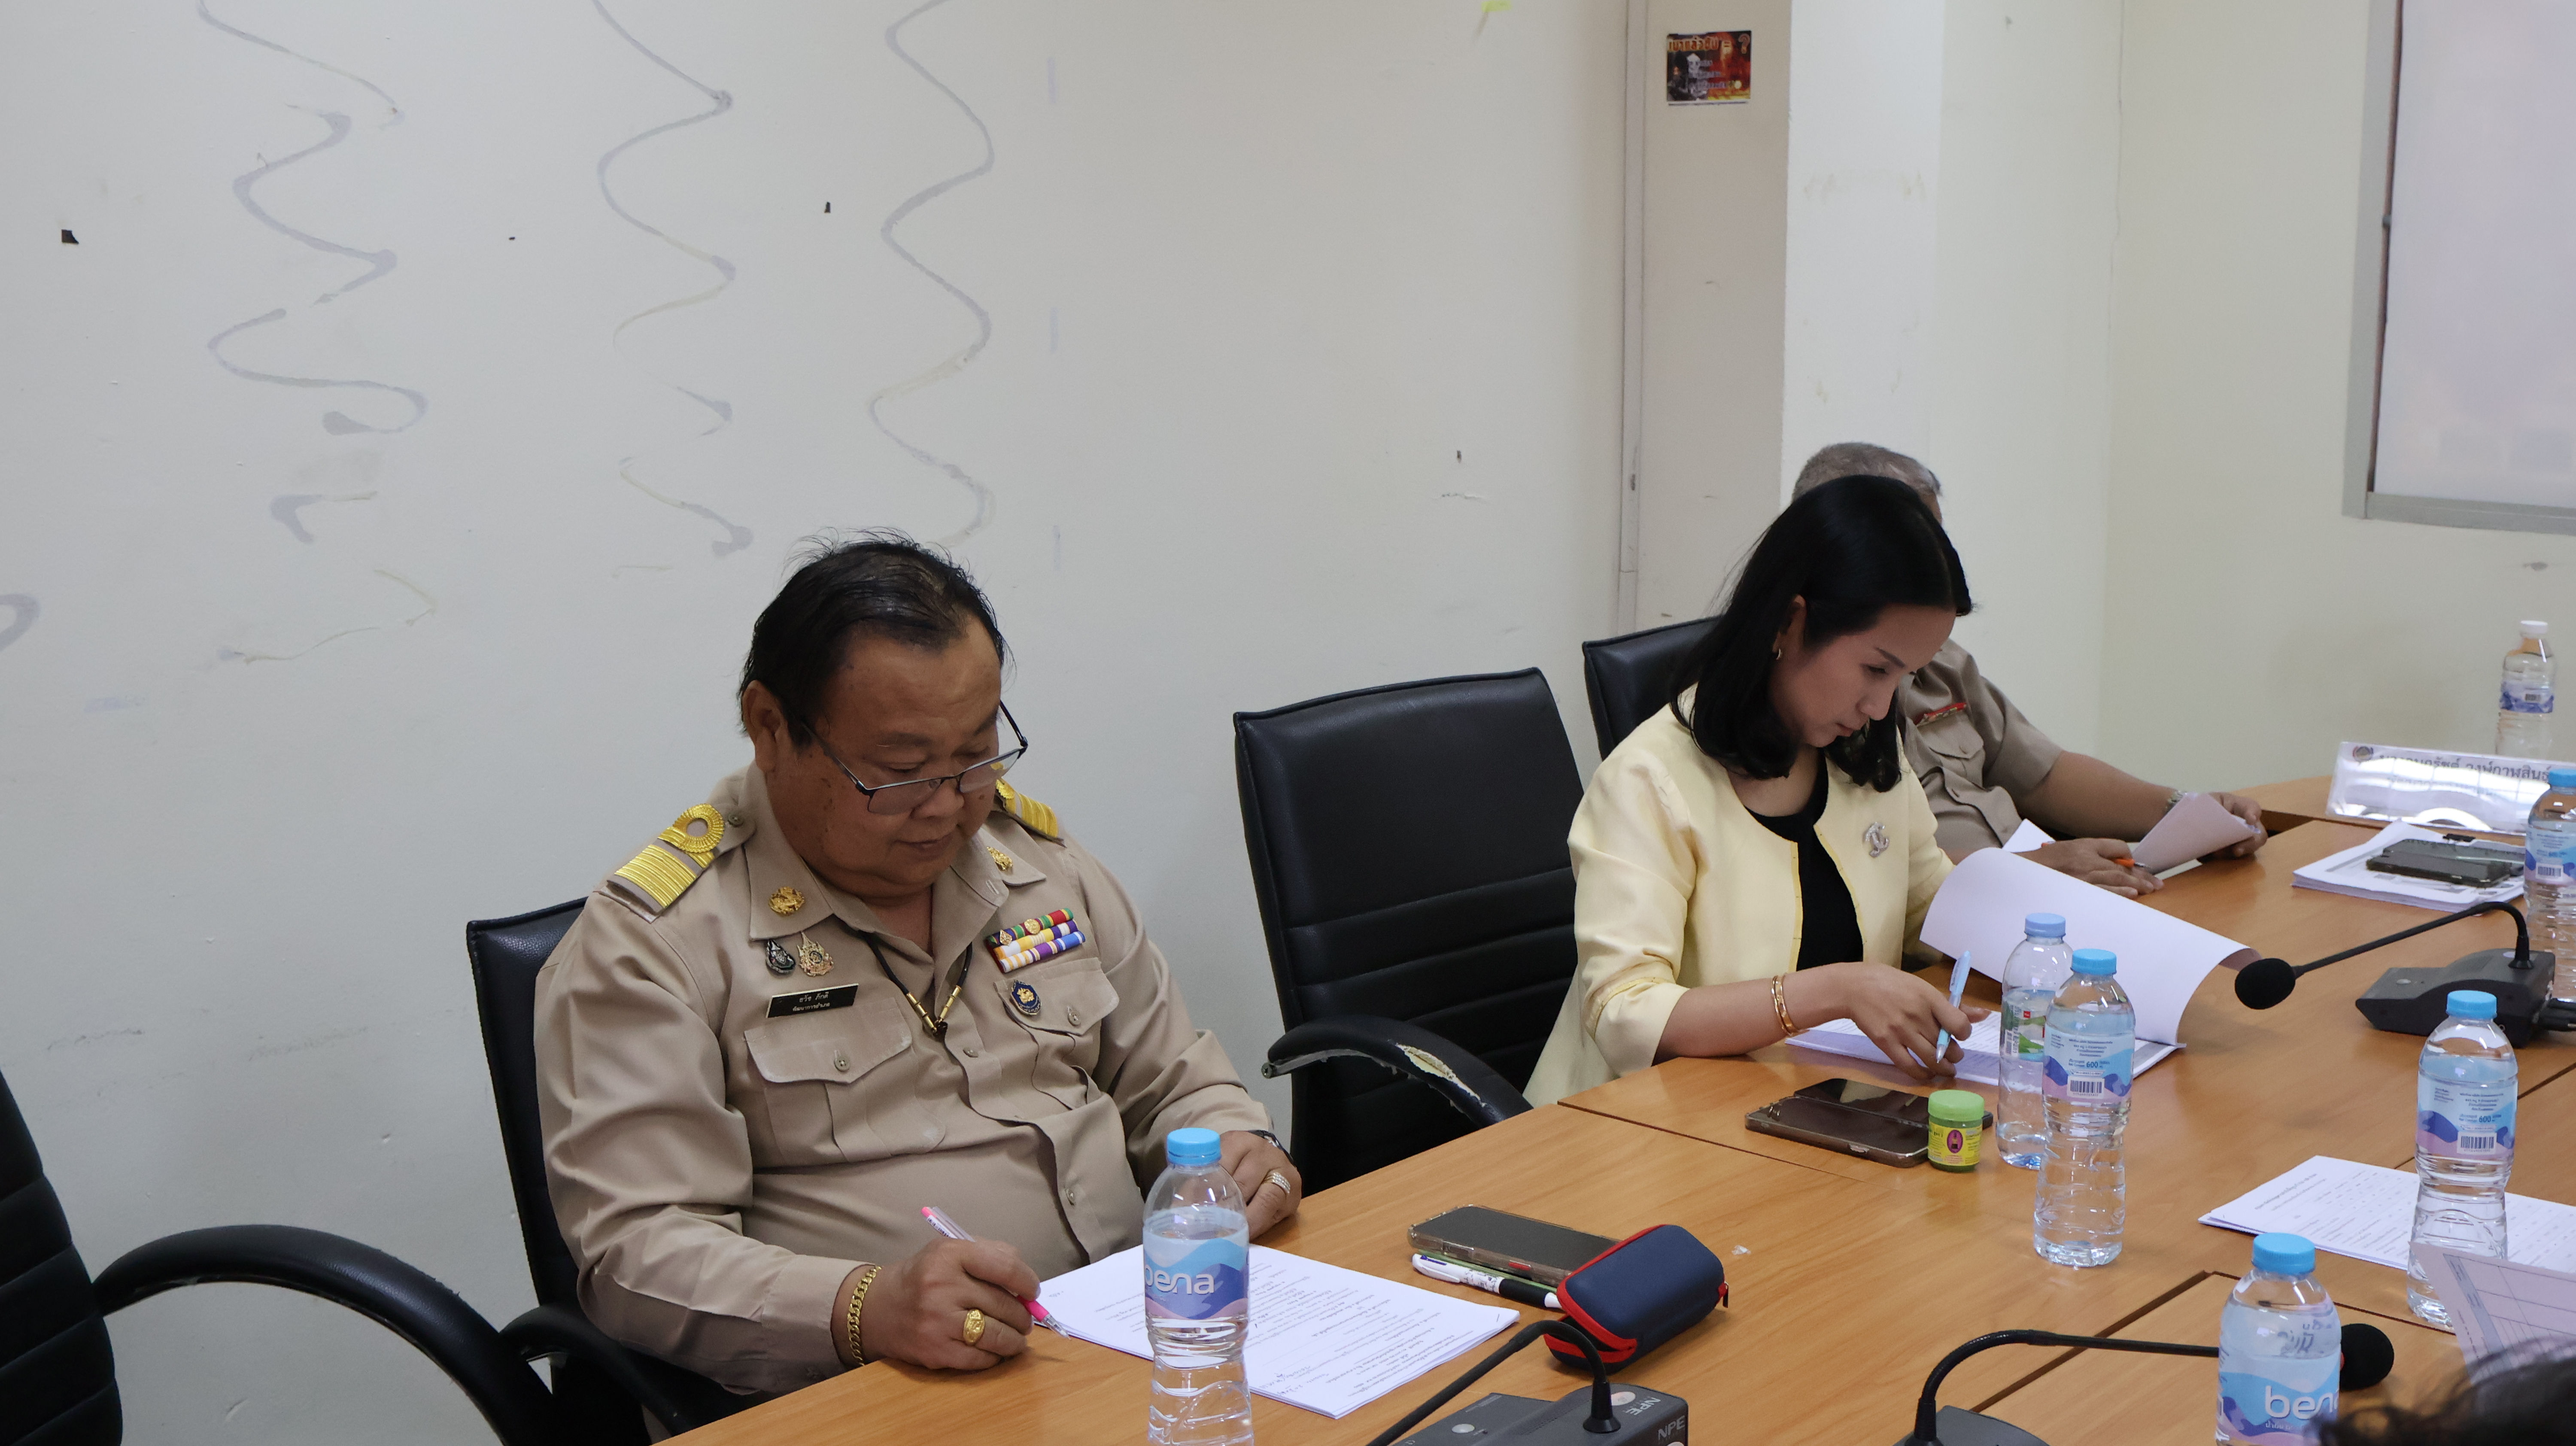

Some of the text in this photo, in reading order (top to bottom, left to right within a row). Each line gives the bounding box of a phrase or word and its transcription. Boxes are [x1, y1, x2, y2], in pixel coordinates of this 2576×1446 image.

[1625, 1397, 1661, 1416] NPE
[2265, 1385, 2338, 1420] ben
[1658, 1415, 1685, 1440] NPE
